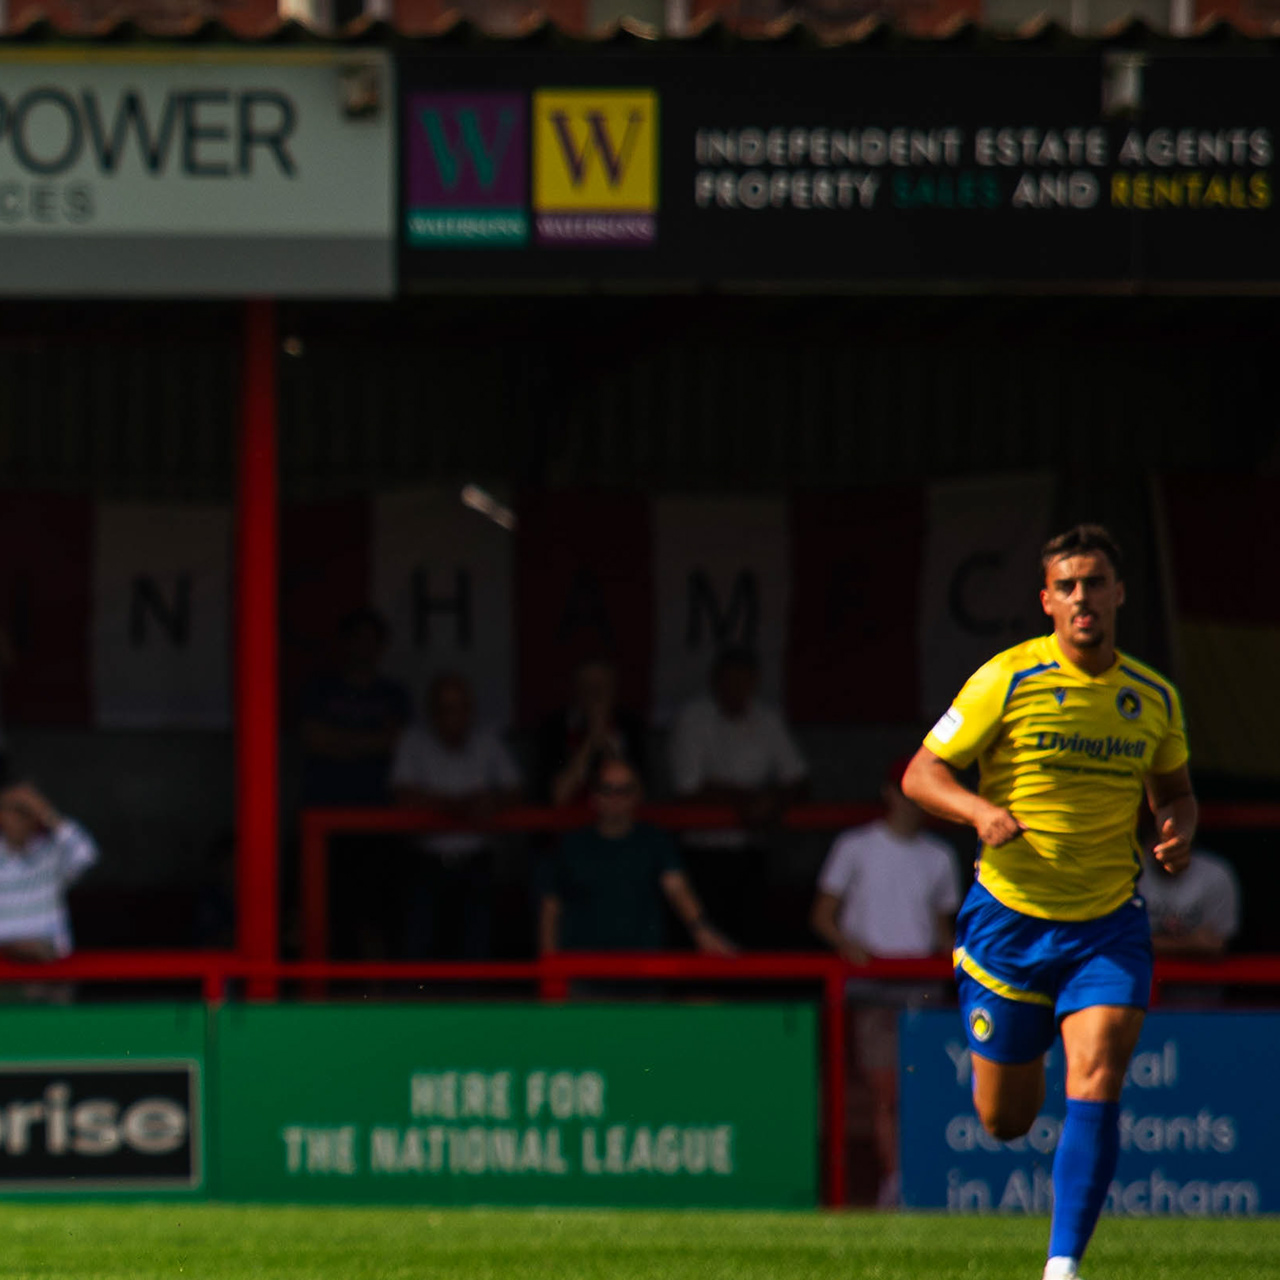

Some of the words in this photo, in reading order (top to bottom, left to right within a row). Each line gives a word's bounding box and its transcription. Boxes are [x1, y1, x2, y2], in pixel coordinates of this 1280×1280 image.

[550, 107, 646, 190] W
[695, 126, 963, 167] INDEPENDENT
[975, 127, 1109, 167] ESTATE
[1118, 128, 1274, 167] AGENTS
[695, 169, 880, 210] PROPERTY
[1012, 170, 1100, 210] AND
[1110, 170, 1272, 210] RENTALS
[410, 1070, 513, 1120] HERE
[527, 1071, 605, 1120] FOR
[283, 1126, 355, 1174] THE
[370, 1126, 568, 1174] NATIONAL
[582, 1126, 735, 1174] LEAGUE
